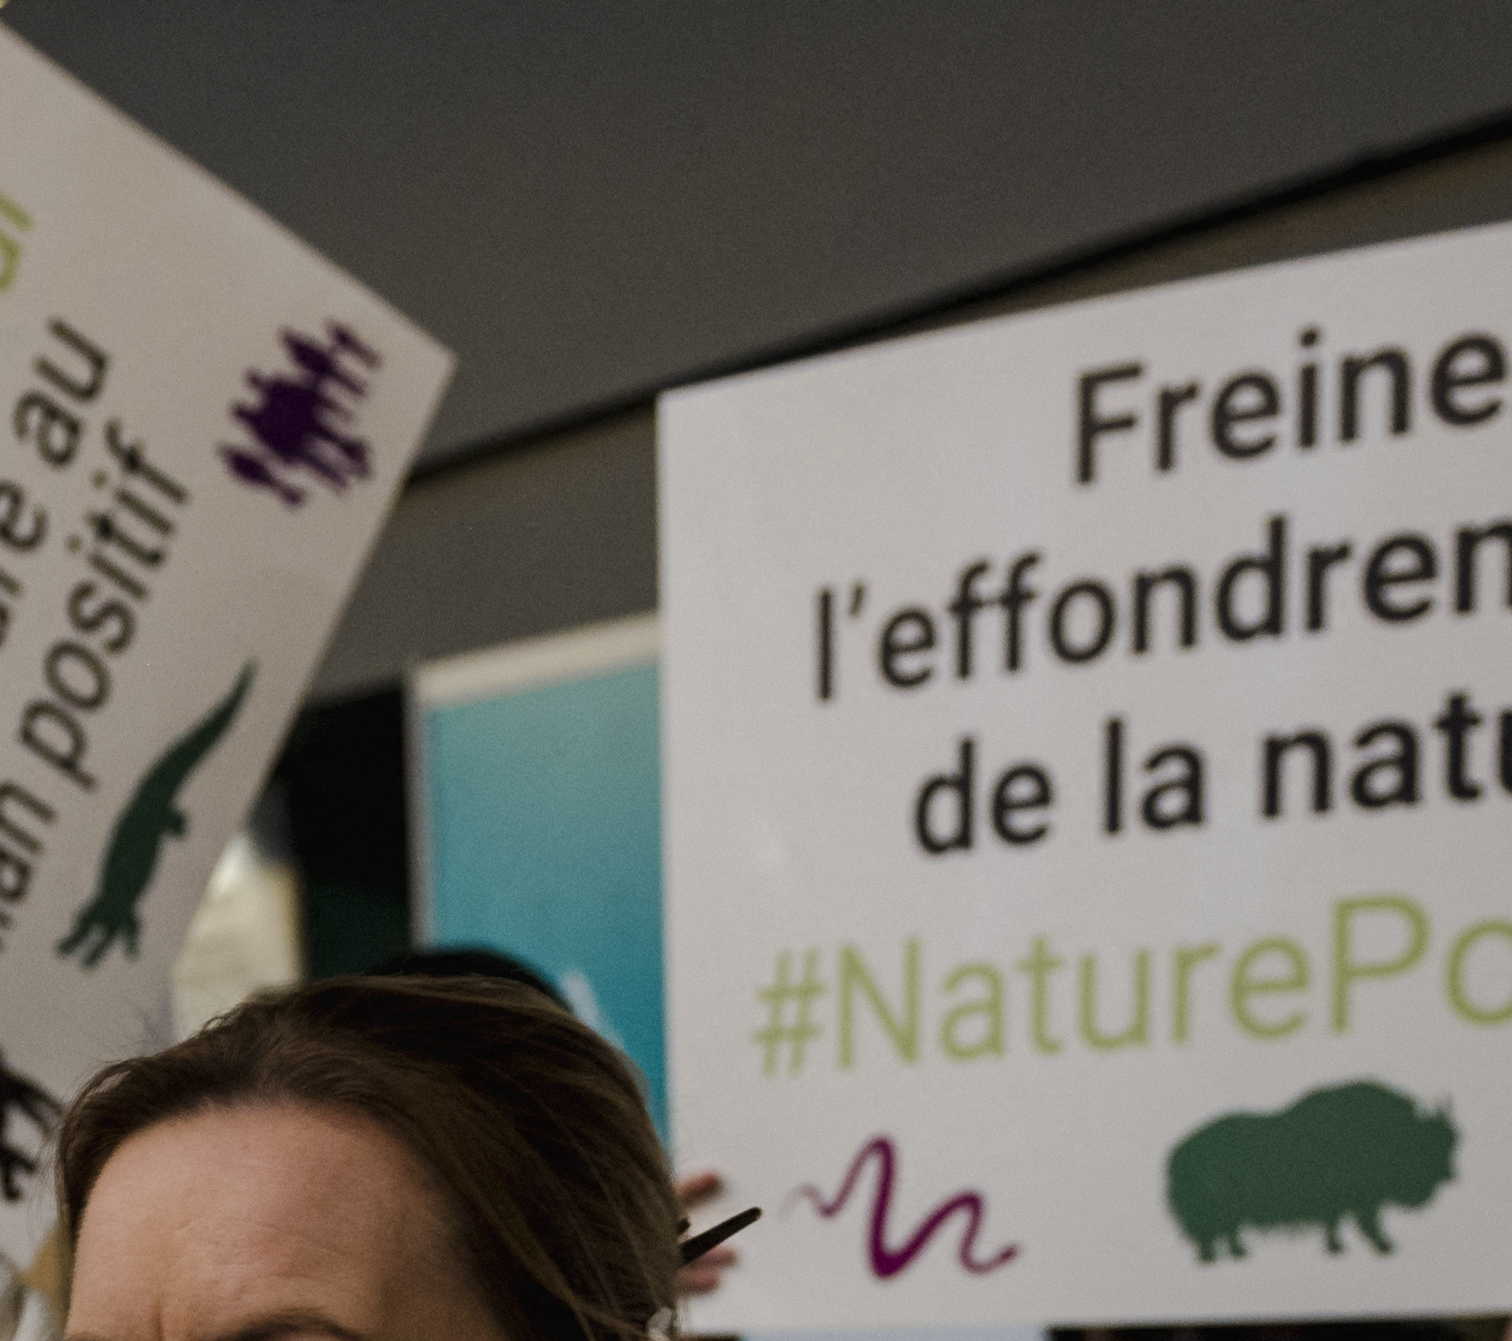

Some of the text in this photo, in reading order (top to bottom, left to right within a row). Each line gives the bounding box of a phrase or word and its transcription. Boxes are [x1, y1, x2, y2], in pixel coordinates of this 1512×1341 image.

[12, 316, 113, 471] au
[16, 417, 193, 792] positif
[916, 740, 1054, 856] de
[1104, 719, 1211, 835] la
